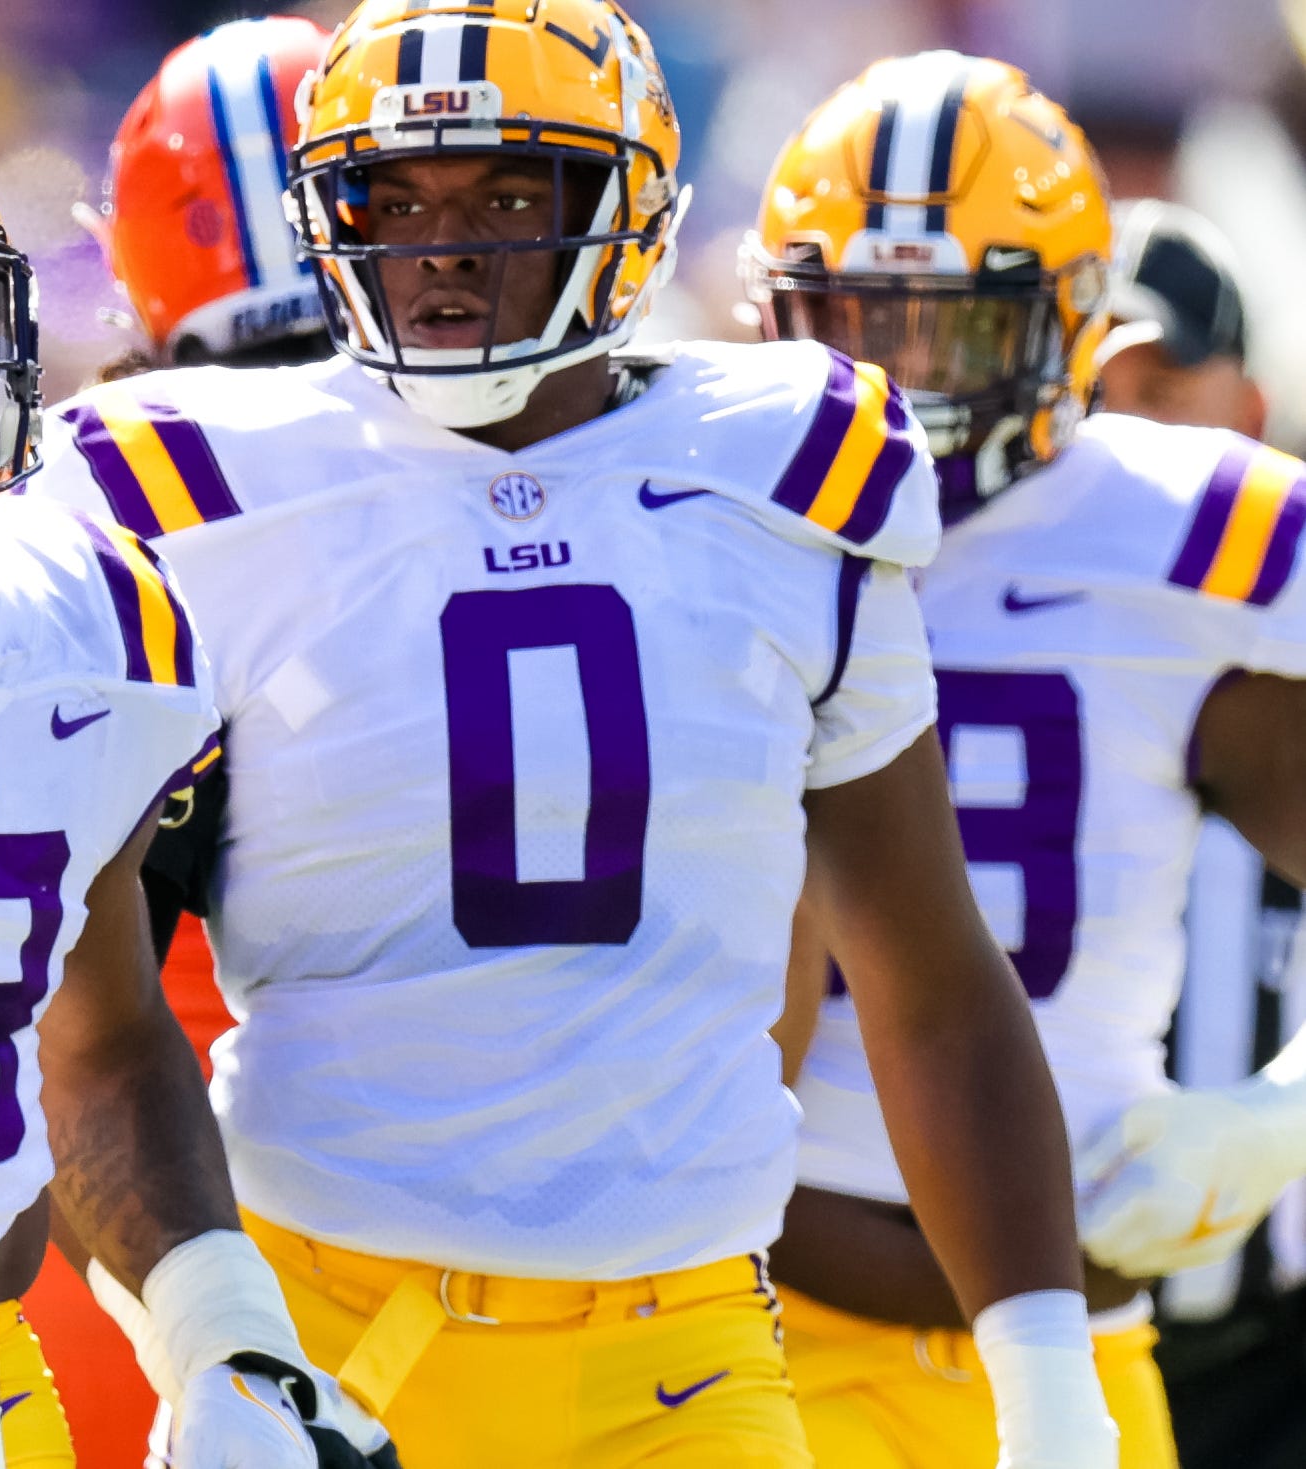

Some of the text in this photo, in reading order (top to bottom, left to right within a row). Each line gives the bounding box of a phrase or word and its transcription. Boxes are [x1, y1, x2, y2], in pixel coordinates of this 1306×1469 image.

[403, 90, 470, 117] LSU
[491, 475, 544, 519] SEC
[483, 541, 572, 573] LSU
[439, 583, 651, 948] 0
